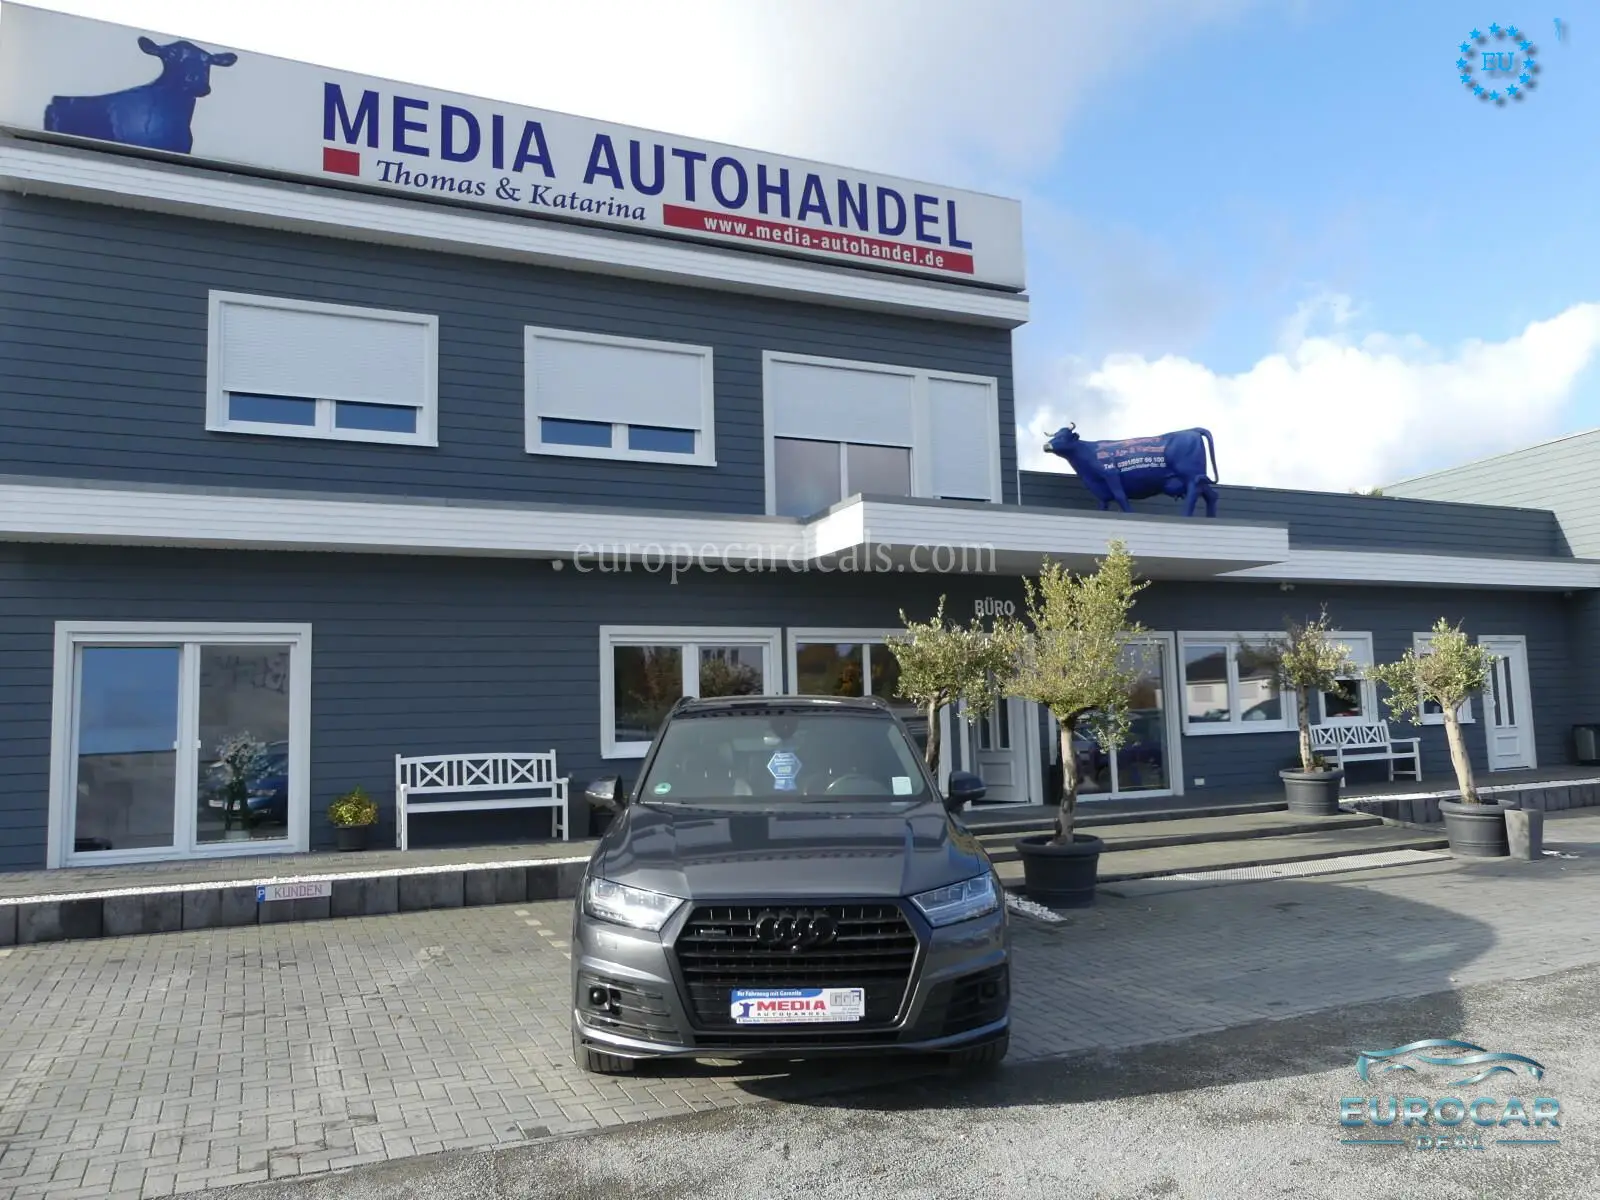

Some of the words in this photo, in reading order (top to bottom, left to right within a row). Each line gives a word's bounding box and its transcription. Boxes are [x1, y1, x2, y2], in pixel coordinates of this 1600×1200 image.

[322, 81, 556, 180] MEDIA
[583, 133, 973, 250] AUTOHANDEL
[376, 159, 486, 197] Thomas
[495, 177, 521, 202] &
[528, 183, 647, 221] Katarina
[703, 214, 945, 268] www.media-autohandel.de
[974, 596, 1016, 616] BÜRO
[274, 884, 323, 898] KUNDEN
[745, 990, 769, 998] Fahrzeug
[756, 1000, 827, 1011] MEDIA
